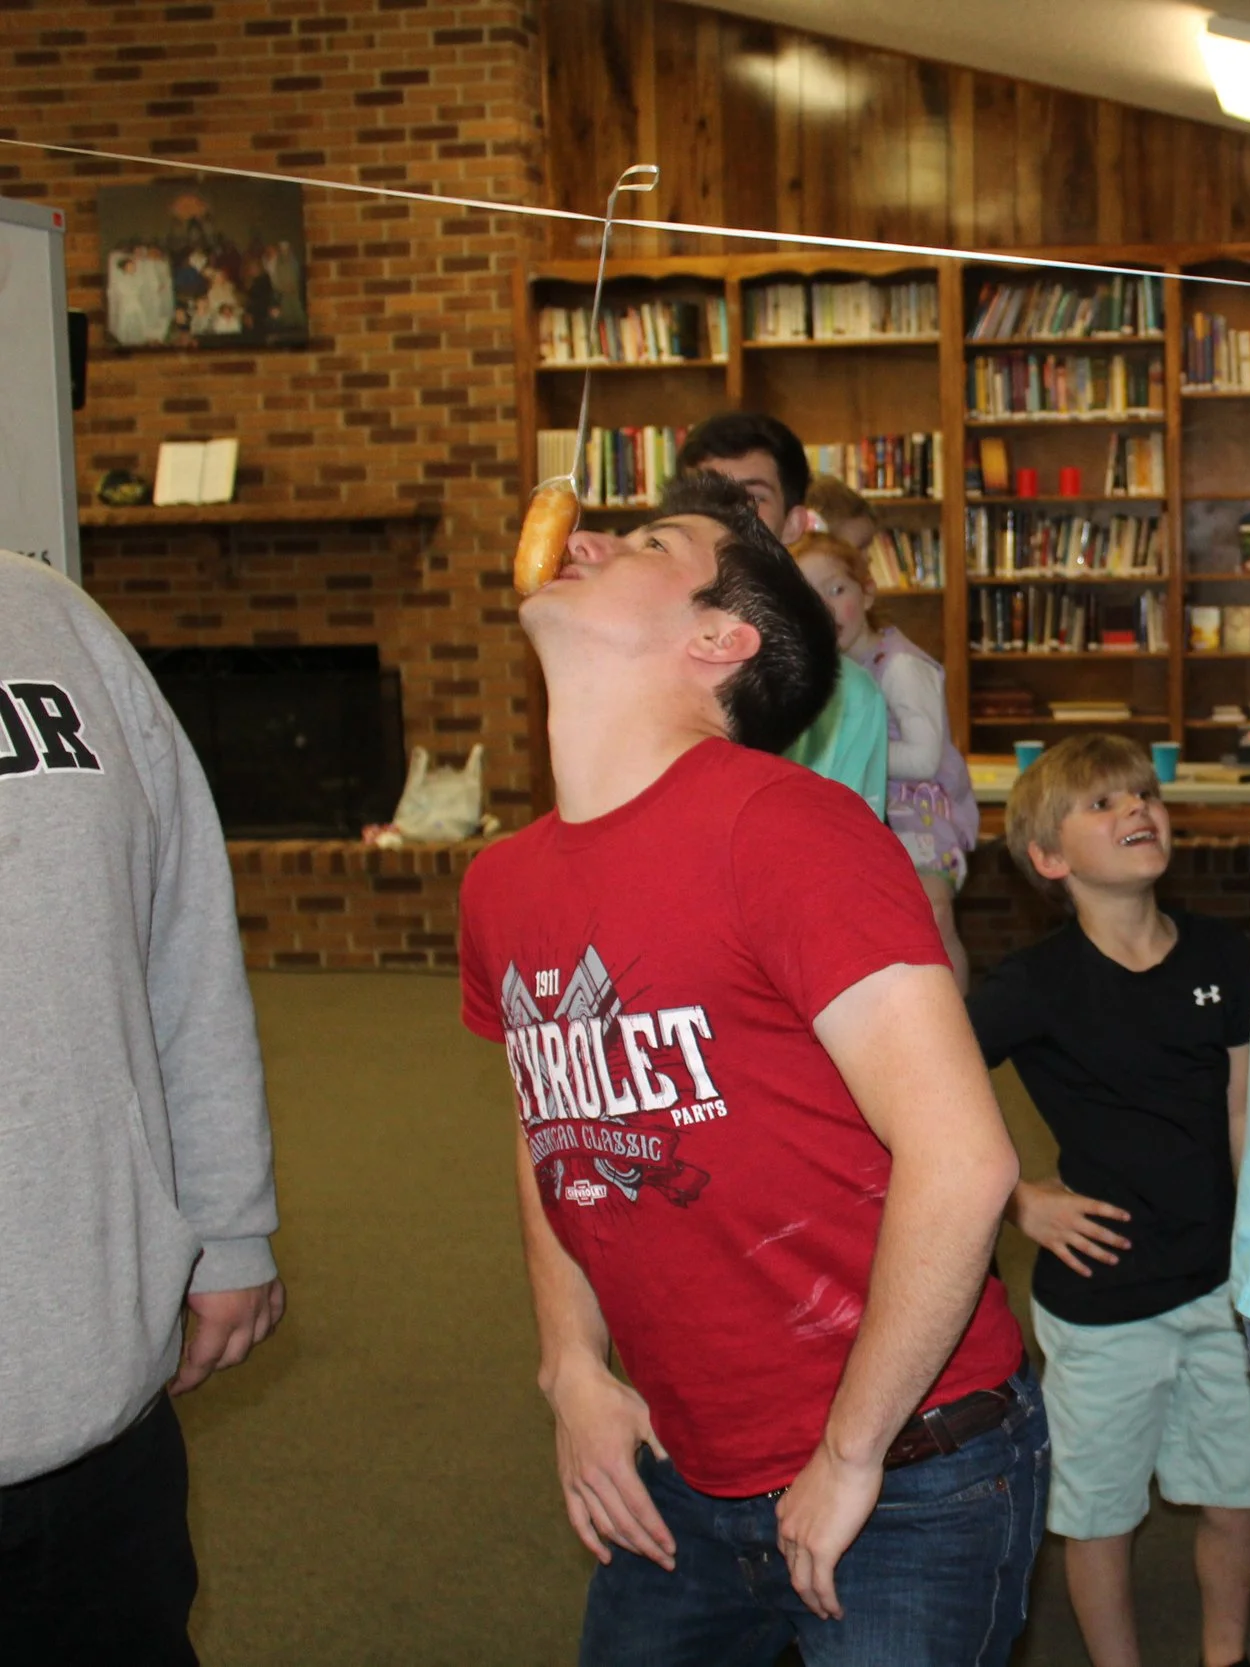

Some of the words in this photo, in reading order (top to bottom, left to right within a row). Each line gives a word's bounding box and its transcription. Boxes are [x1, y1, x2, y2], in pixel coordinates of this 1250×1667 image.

[534, 968, 560, 998] 1911
[670, 1099, 729, 1127] PARTS
[581, 1124, 662, 1162] CLASSIC
